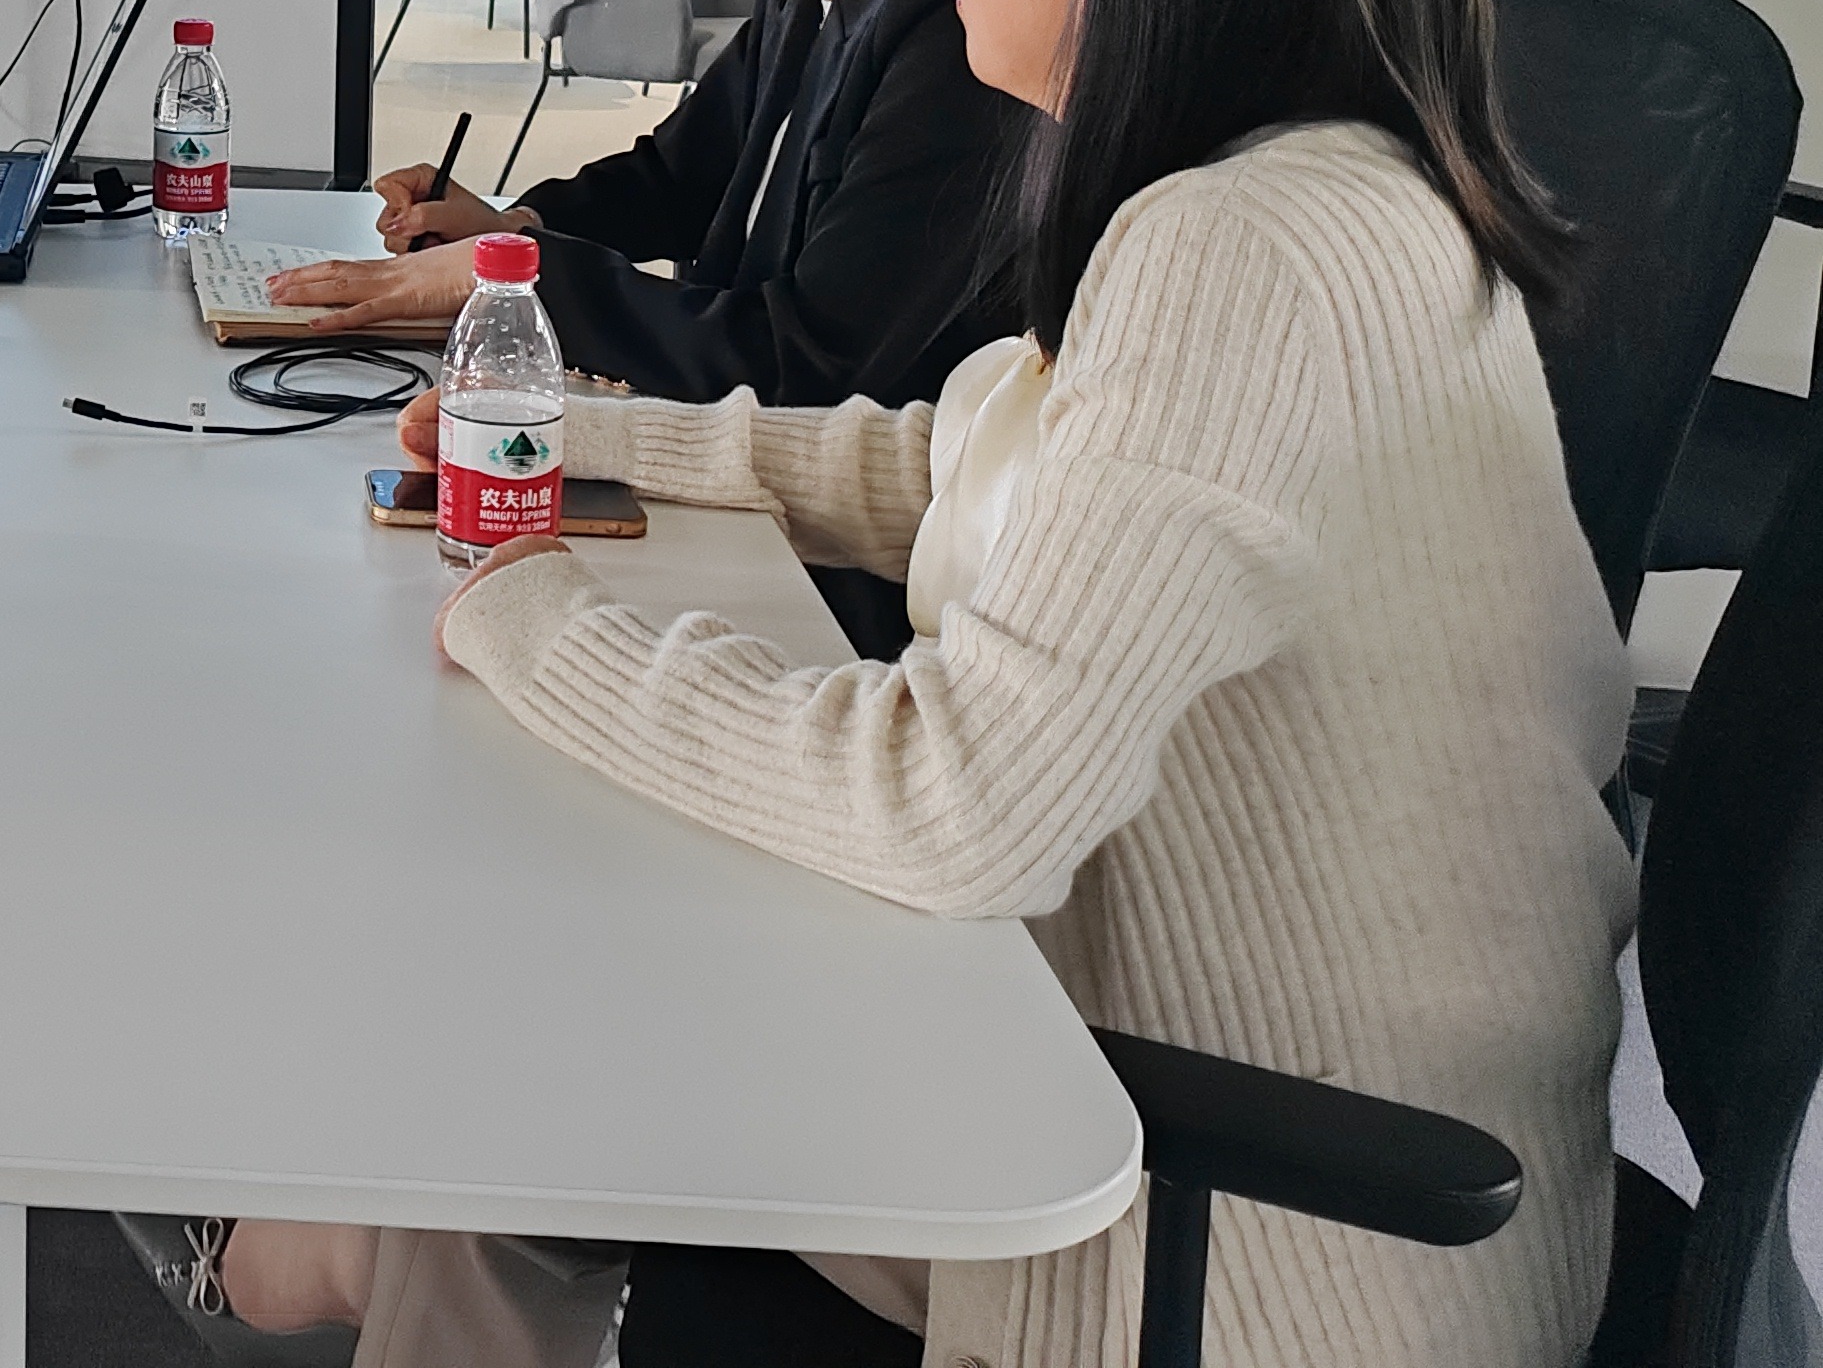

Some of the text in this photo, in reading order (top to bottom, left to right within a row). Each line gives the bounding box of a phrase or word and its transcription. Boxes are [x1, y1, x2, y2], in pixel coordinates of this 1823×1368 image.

[167, 173, 213, 187] 农夫山泉
[479, 486, 552, 509] 农夫山泉
[479, 508, 519, 522] NONGFU
